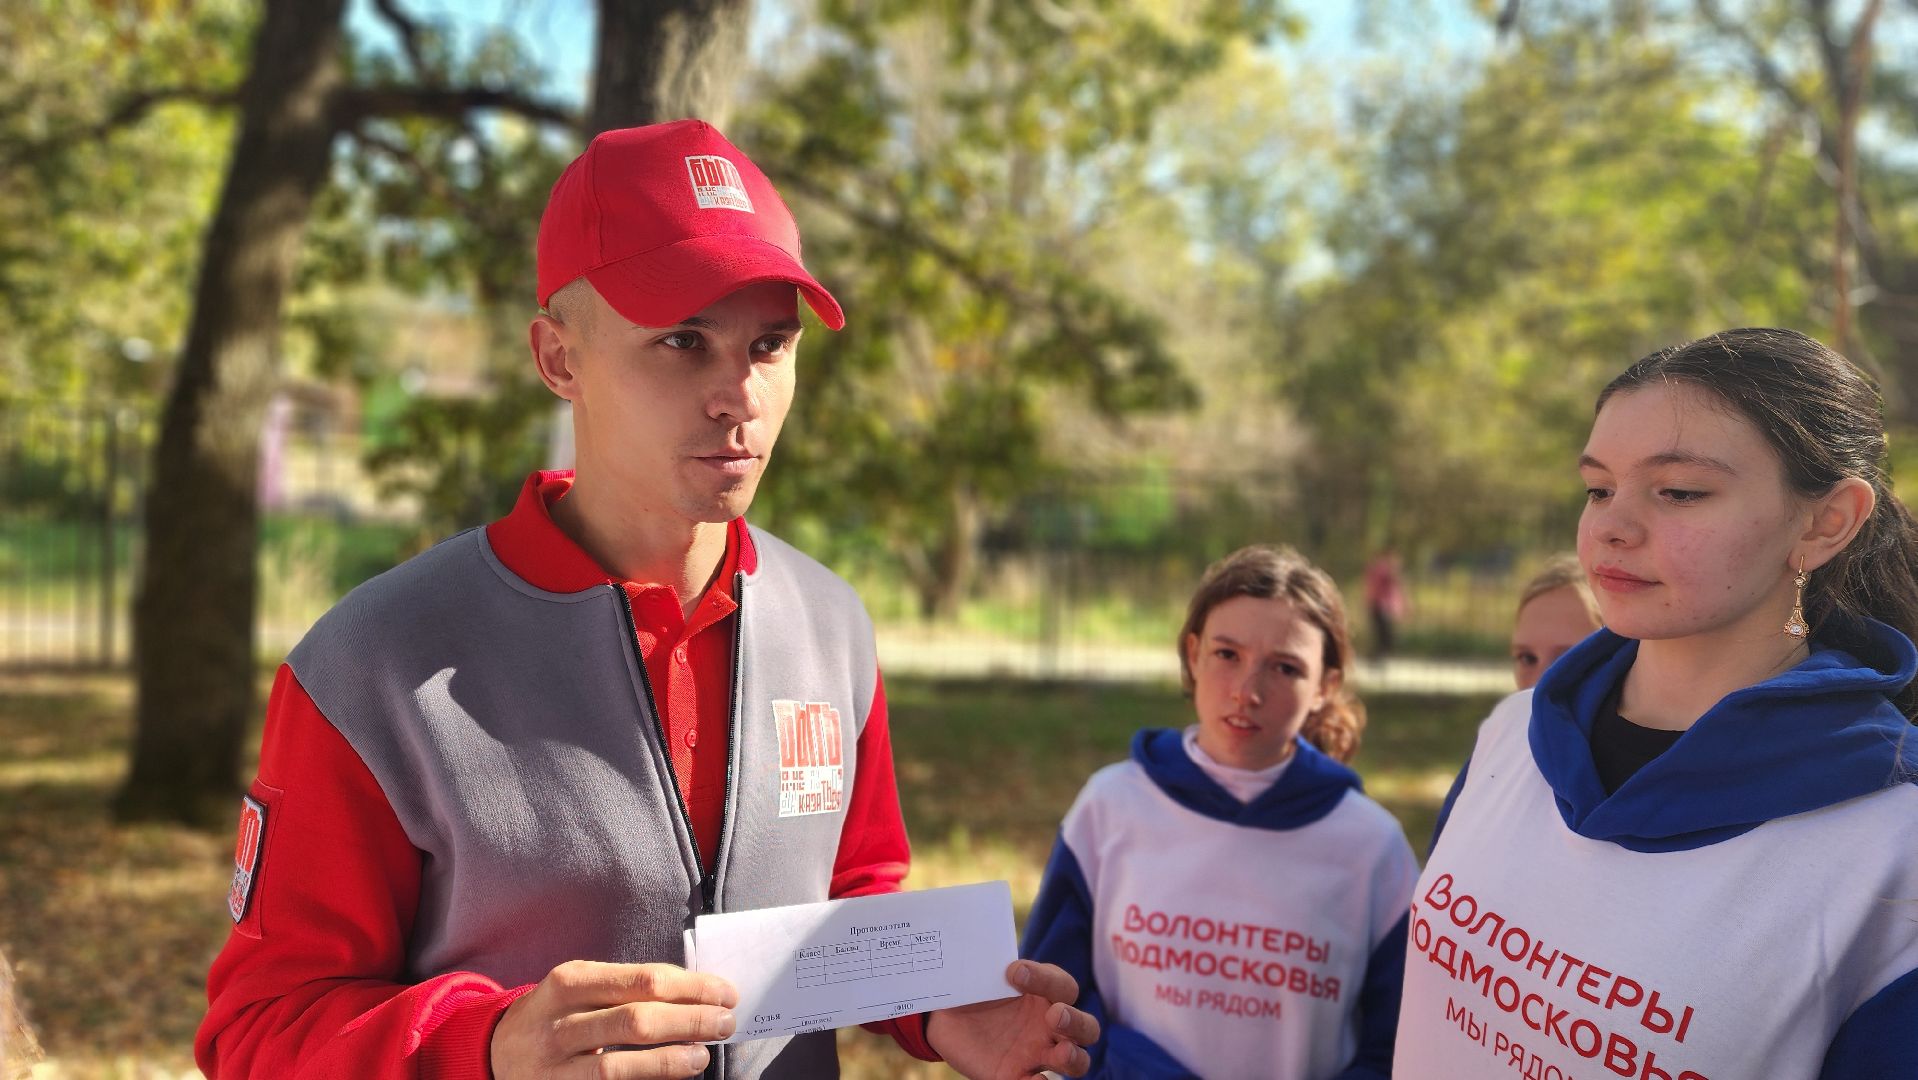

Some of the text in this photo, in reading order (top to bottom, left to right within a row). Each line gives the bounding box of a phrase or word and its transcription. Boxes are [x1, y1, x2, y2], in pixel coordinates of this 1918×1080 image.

[1112, 934, 1342, 1002] ПОДМОСКОВЬЯ
[1124, 904, 1331, 964] ВОЛОНТЕРЫ
[1425, 873, 1695, 1043] ВОЛОНТЕРЫ
[754, 1012, 781, 1024] Судья
[1156, 985, 1282, 1020] МЫ РЯДОМ
[1411, 903, 1710, 1080] ОДМОСКОВЬ
[1446, 997, 1578, 1080] МЫ РЯДО
